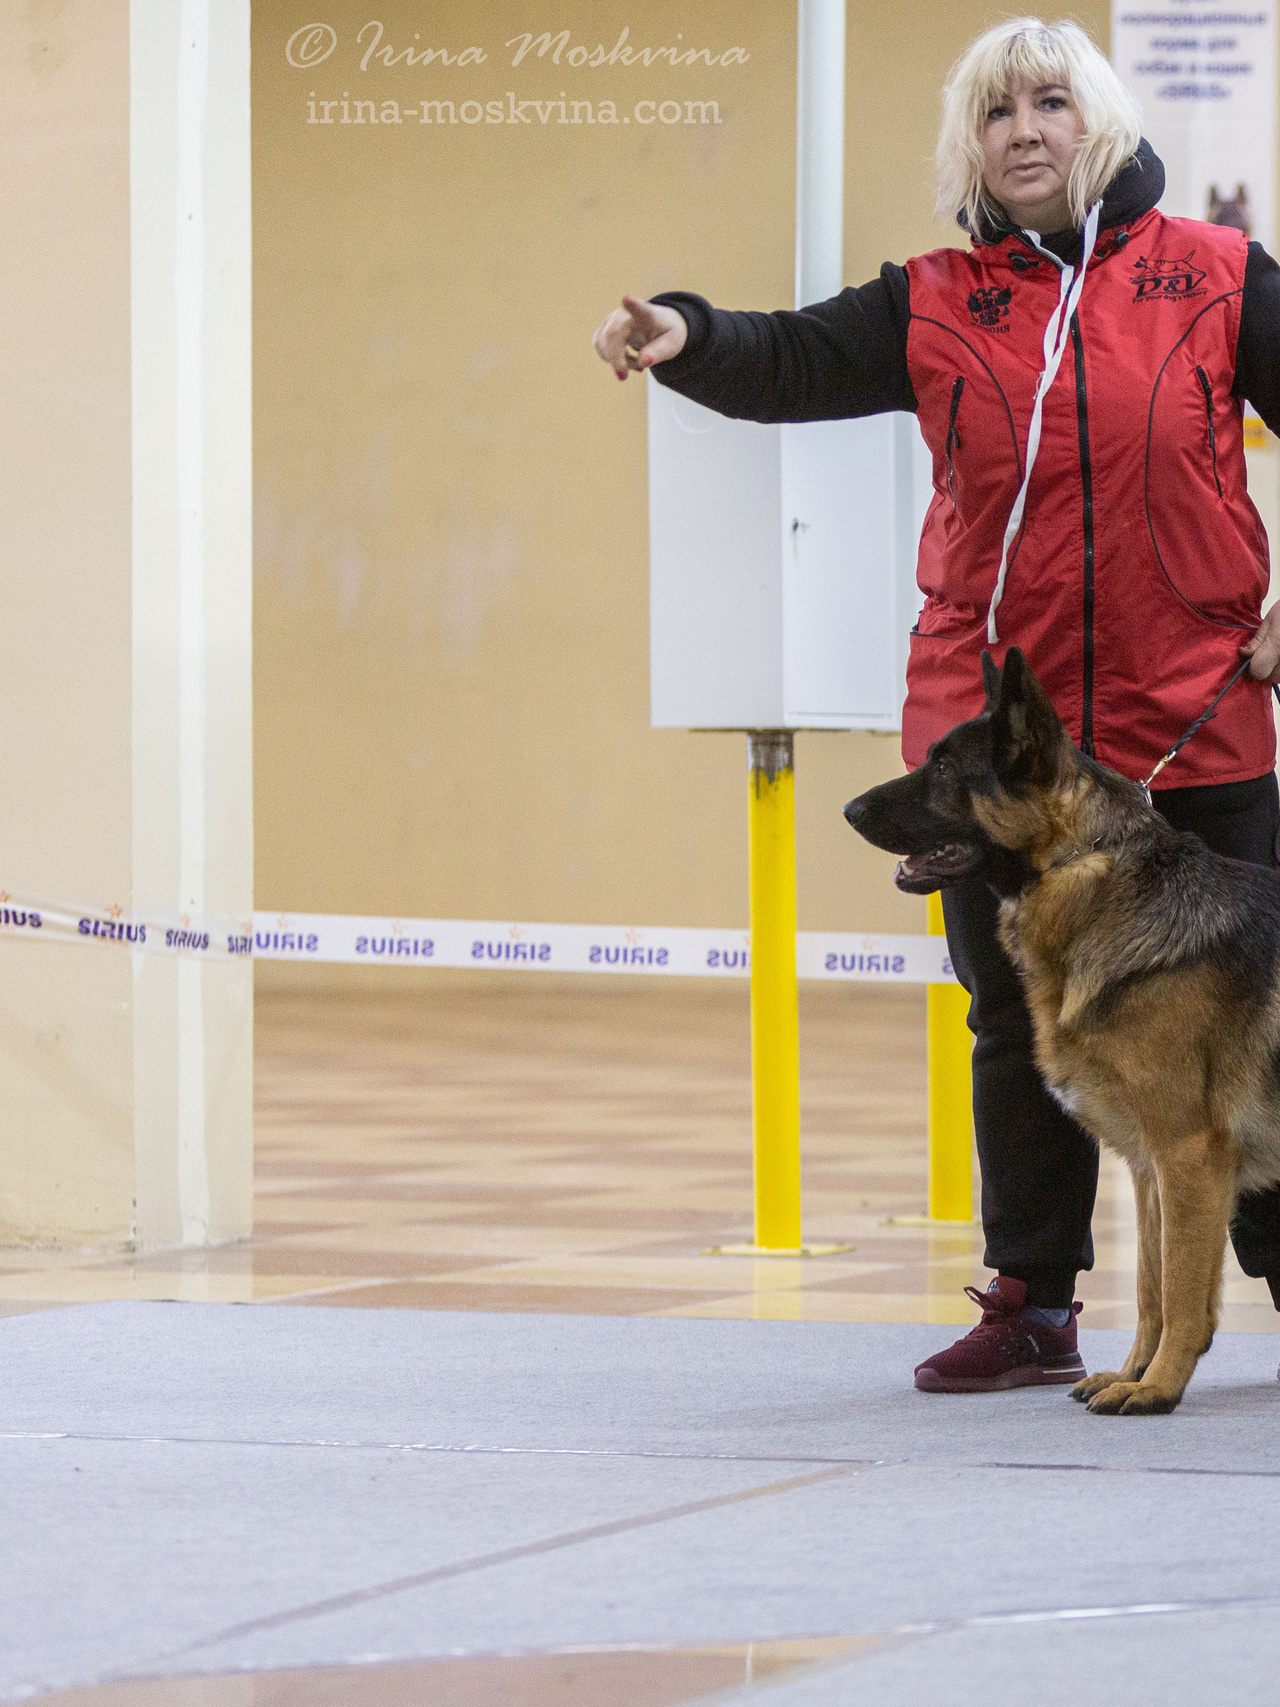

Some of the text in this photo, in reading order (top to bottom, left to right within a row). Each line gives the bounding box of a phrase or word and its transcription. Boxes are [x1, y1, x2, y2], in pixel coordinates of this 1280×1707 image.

[0, 908, 252, 955] IUS SIRIUS SIRIUS SIRI
